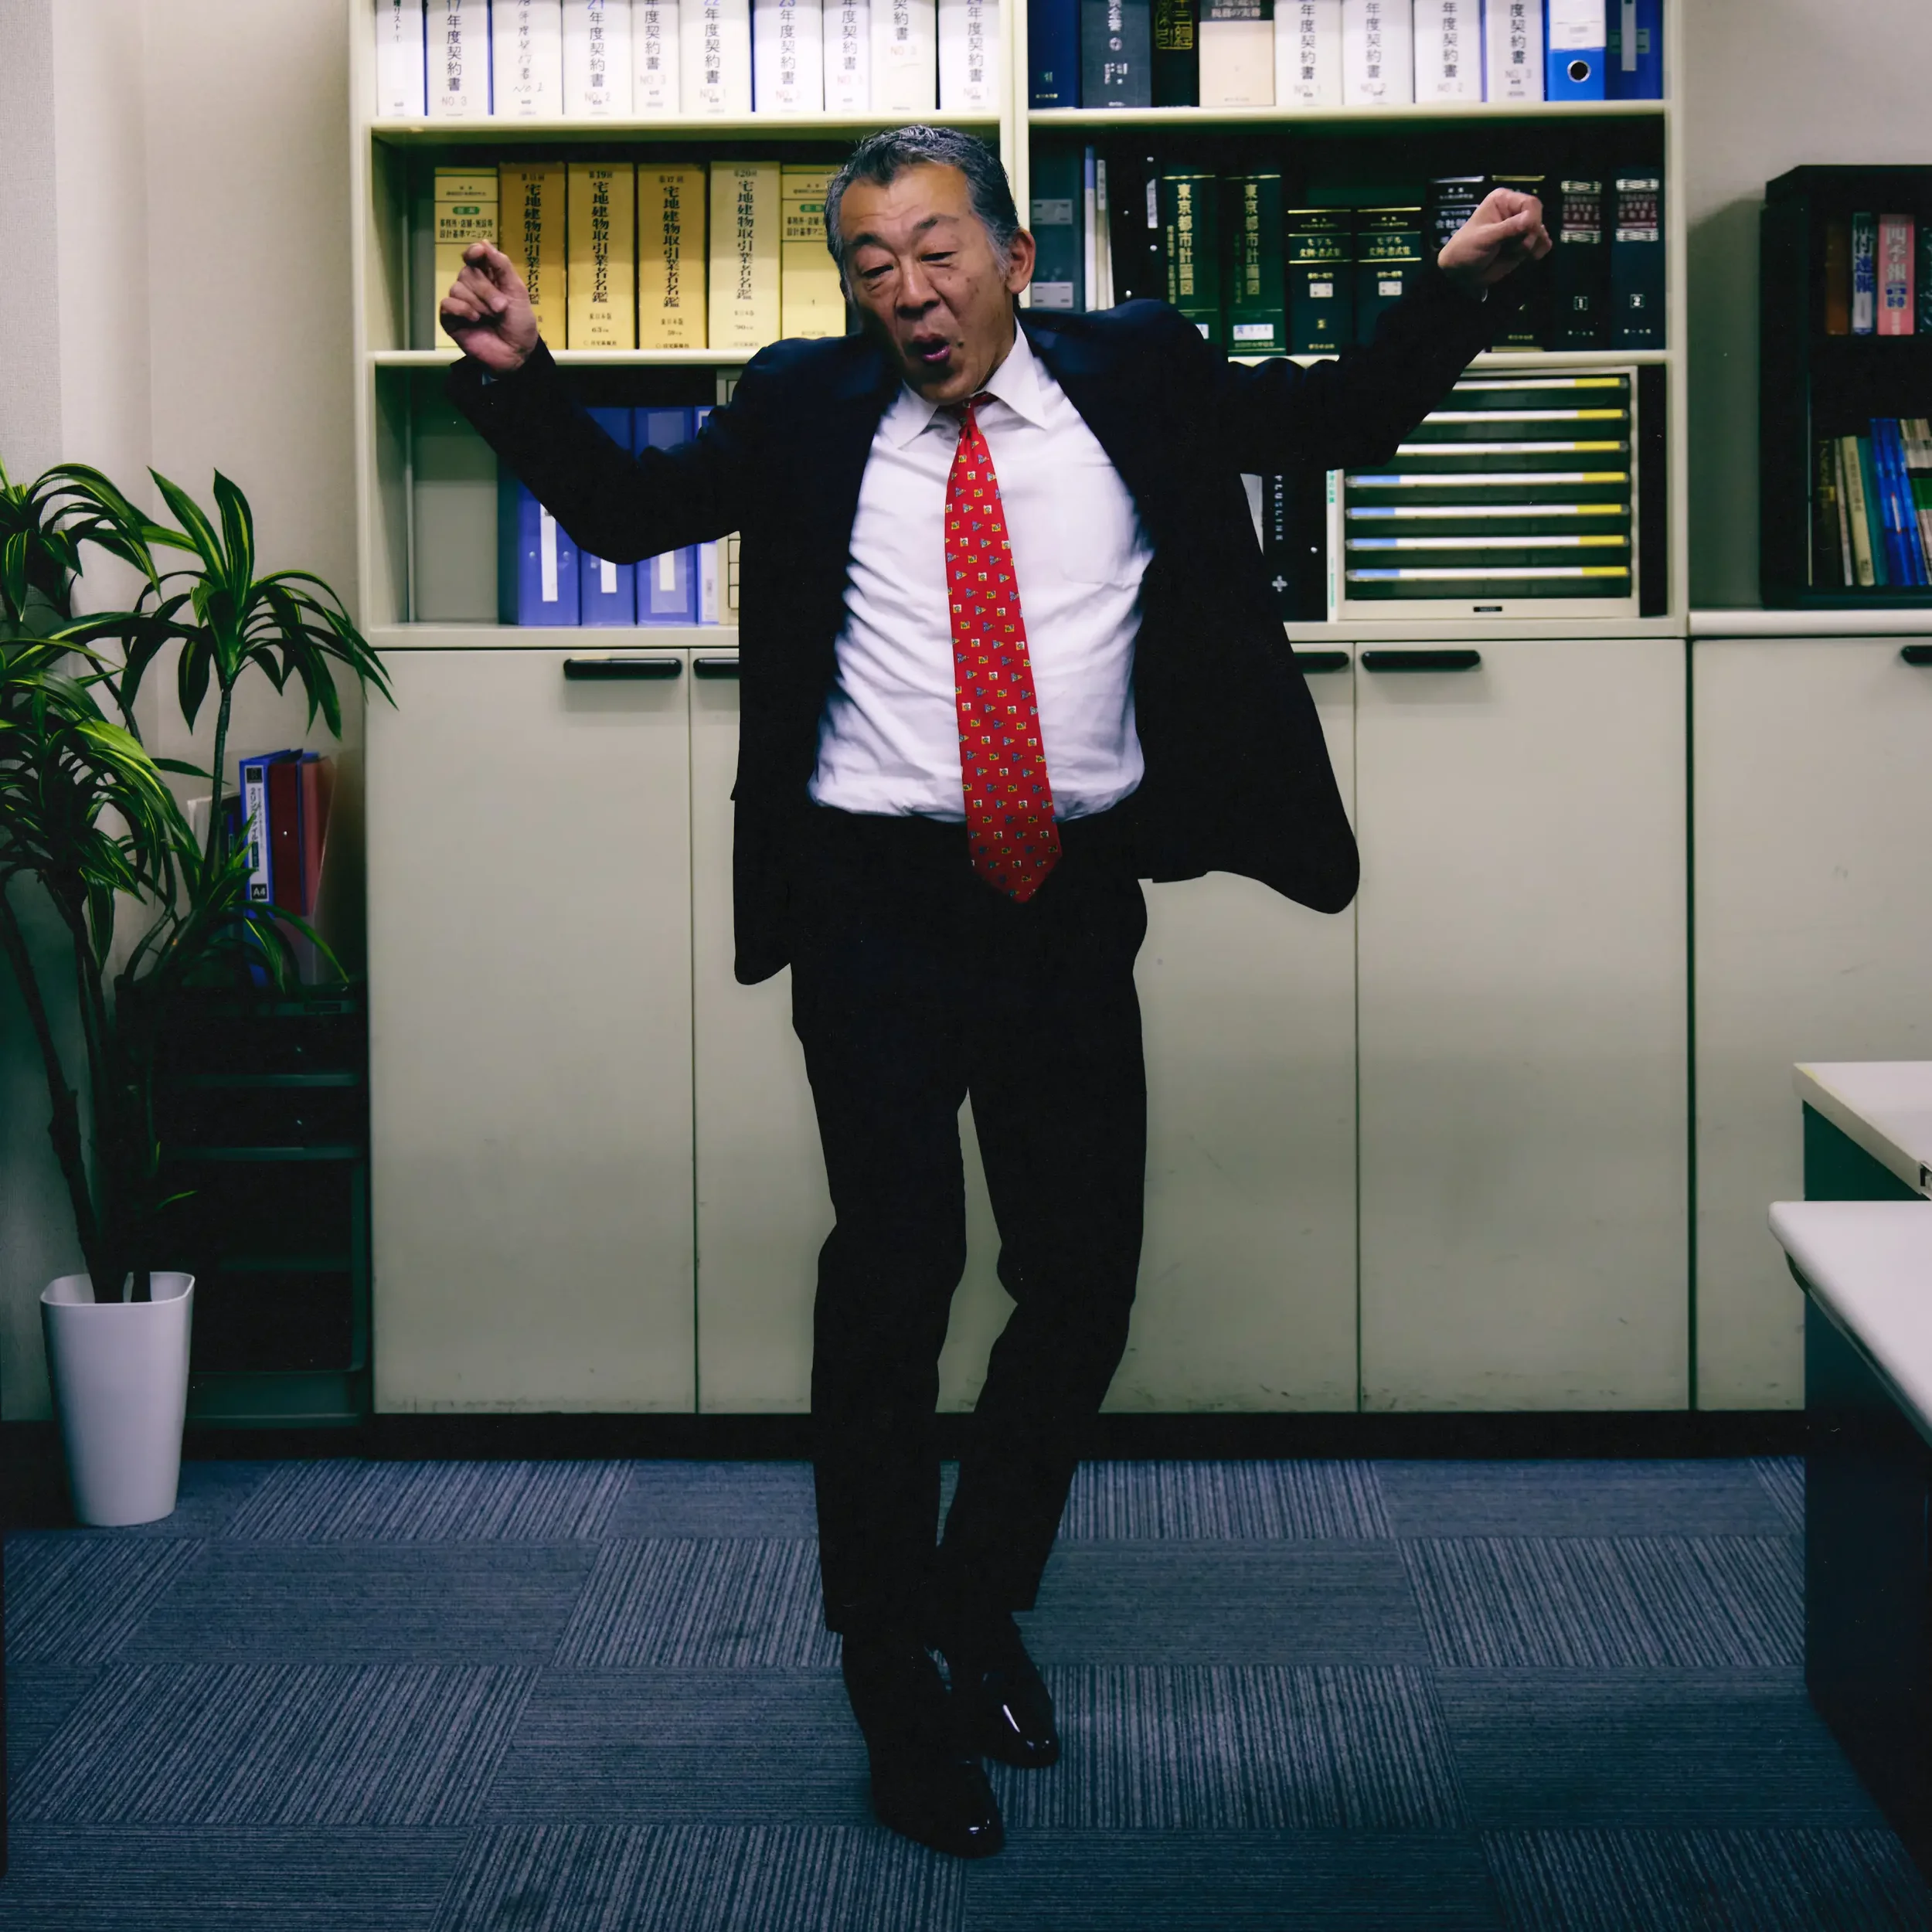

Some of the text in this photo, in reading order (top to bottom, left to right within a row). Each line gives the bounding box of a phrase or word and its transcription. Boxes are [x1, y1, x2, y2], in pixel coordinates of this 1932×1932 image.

[592, 181, 610, 303] 宅地建物取引業者名鑑
[663, 186, 680, 308] 宅地建物取引業者名鑑
[253, 887, 266, 897] A4
